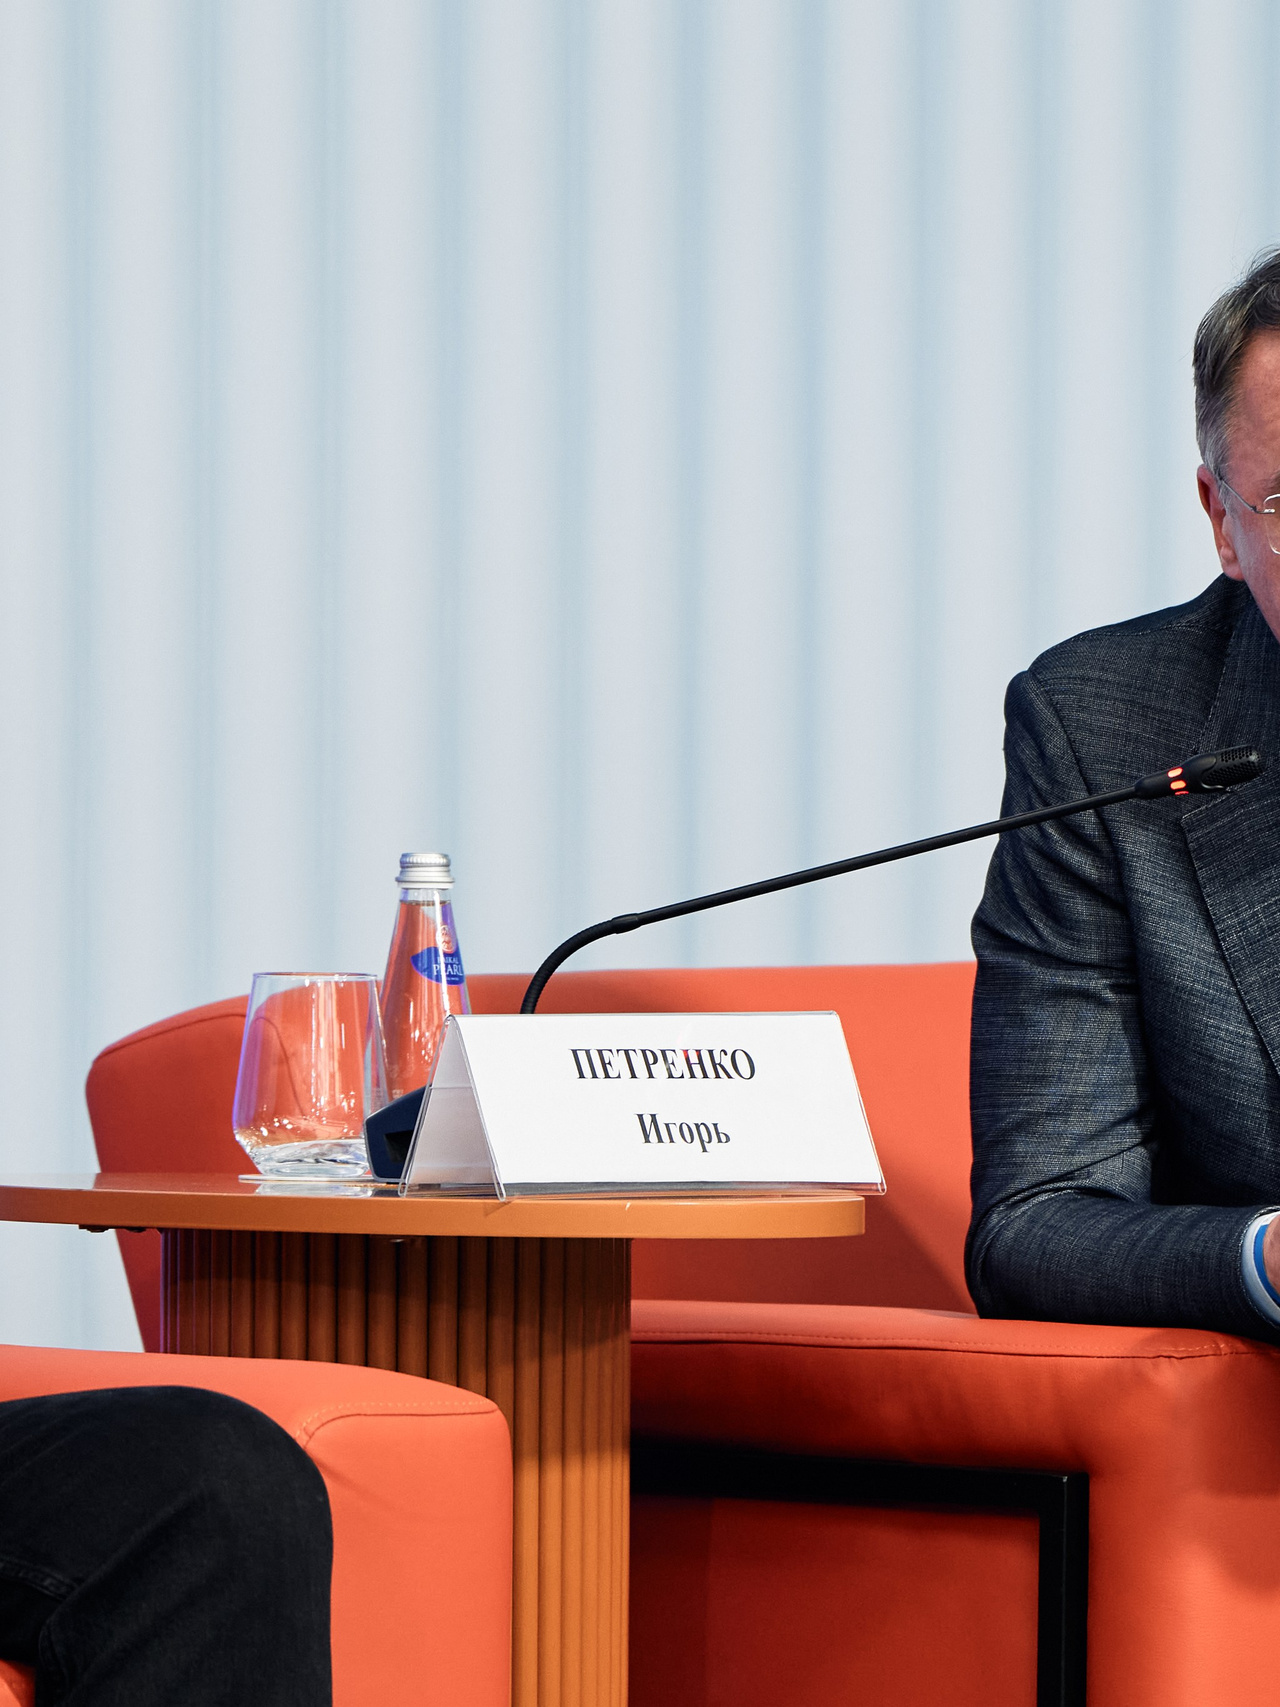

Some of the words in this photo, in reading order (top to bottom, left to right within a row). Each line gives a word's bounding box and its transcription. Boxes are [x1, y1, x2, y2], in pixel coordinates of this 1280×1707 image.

[433, 964, 463, 976] PARL
[437, 956, 459, 964] IKAL
[570, 1048, 756, 1081] ПЕТРЕНКО
[635, 1113, 731, 1153] Игорь
